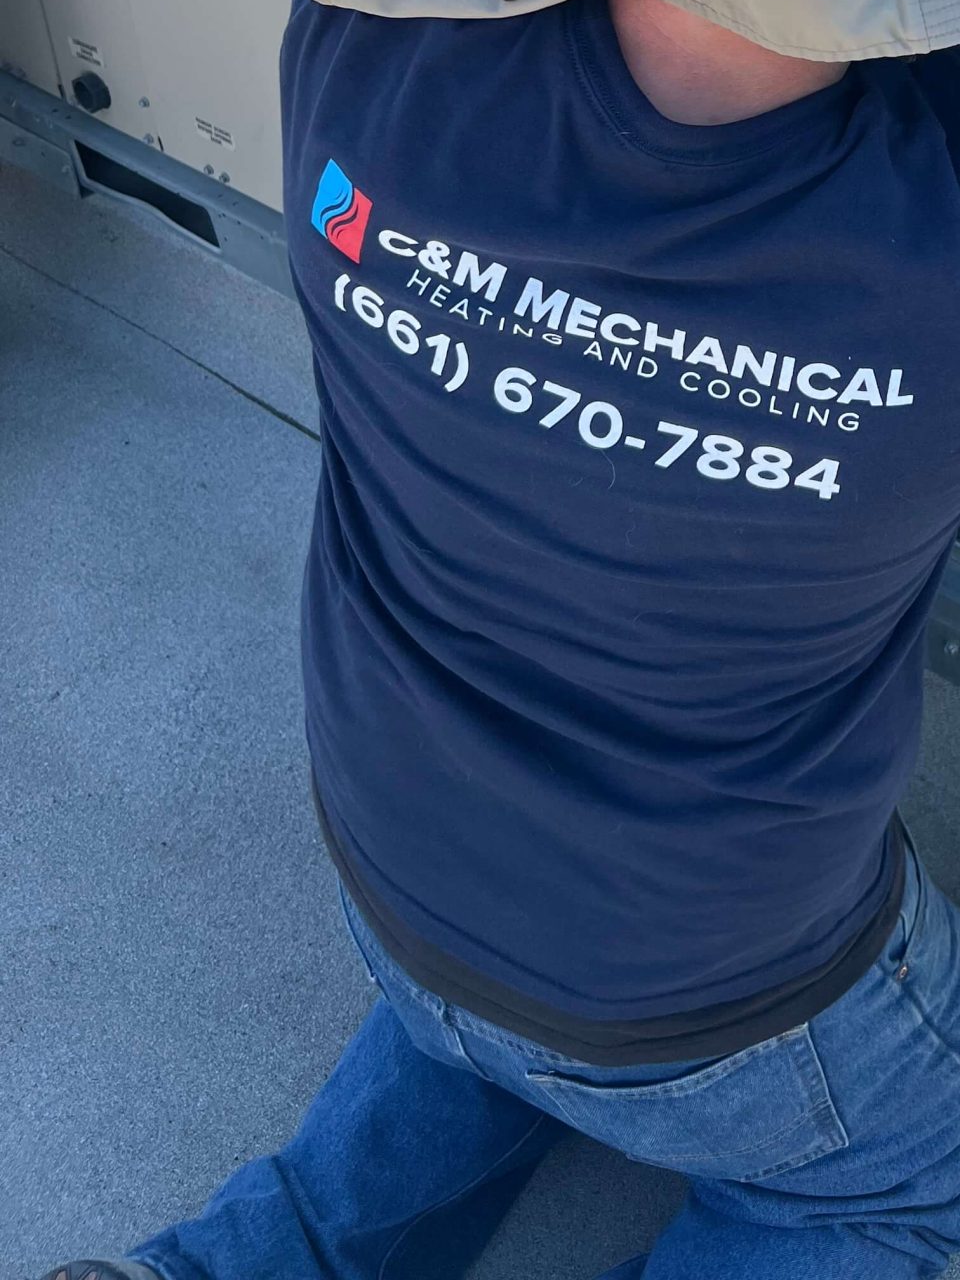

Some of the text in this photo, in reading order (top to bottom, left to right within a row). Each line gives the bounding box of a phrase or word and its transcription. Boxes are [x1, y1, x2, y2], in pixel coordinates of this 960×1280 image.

[334, 273, 841, 500] (661) 670-7884
[378, 229, 914, 407] C&M MECHANICAL
[406, 269, 860, 431] HEATING AND COOLING
